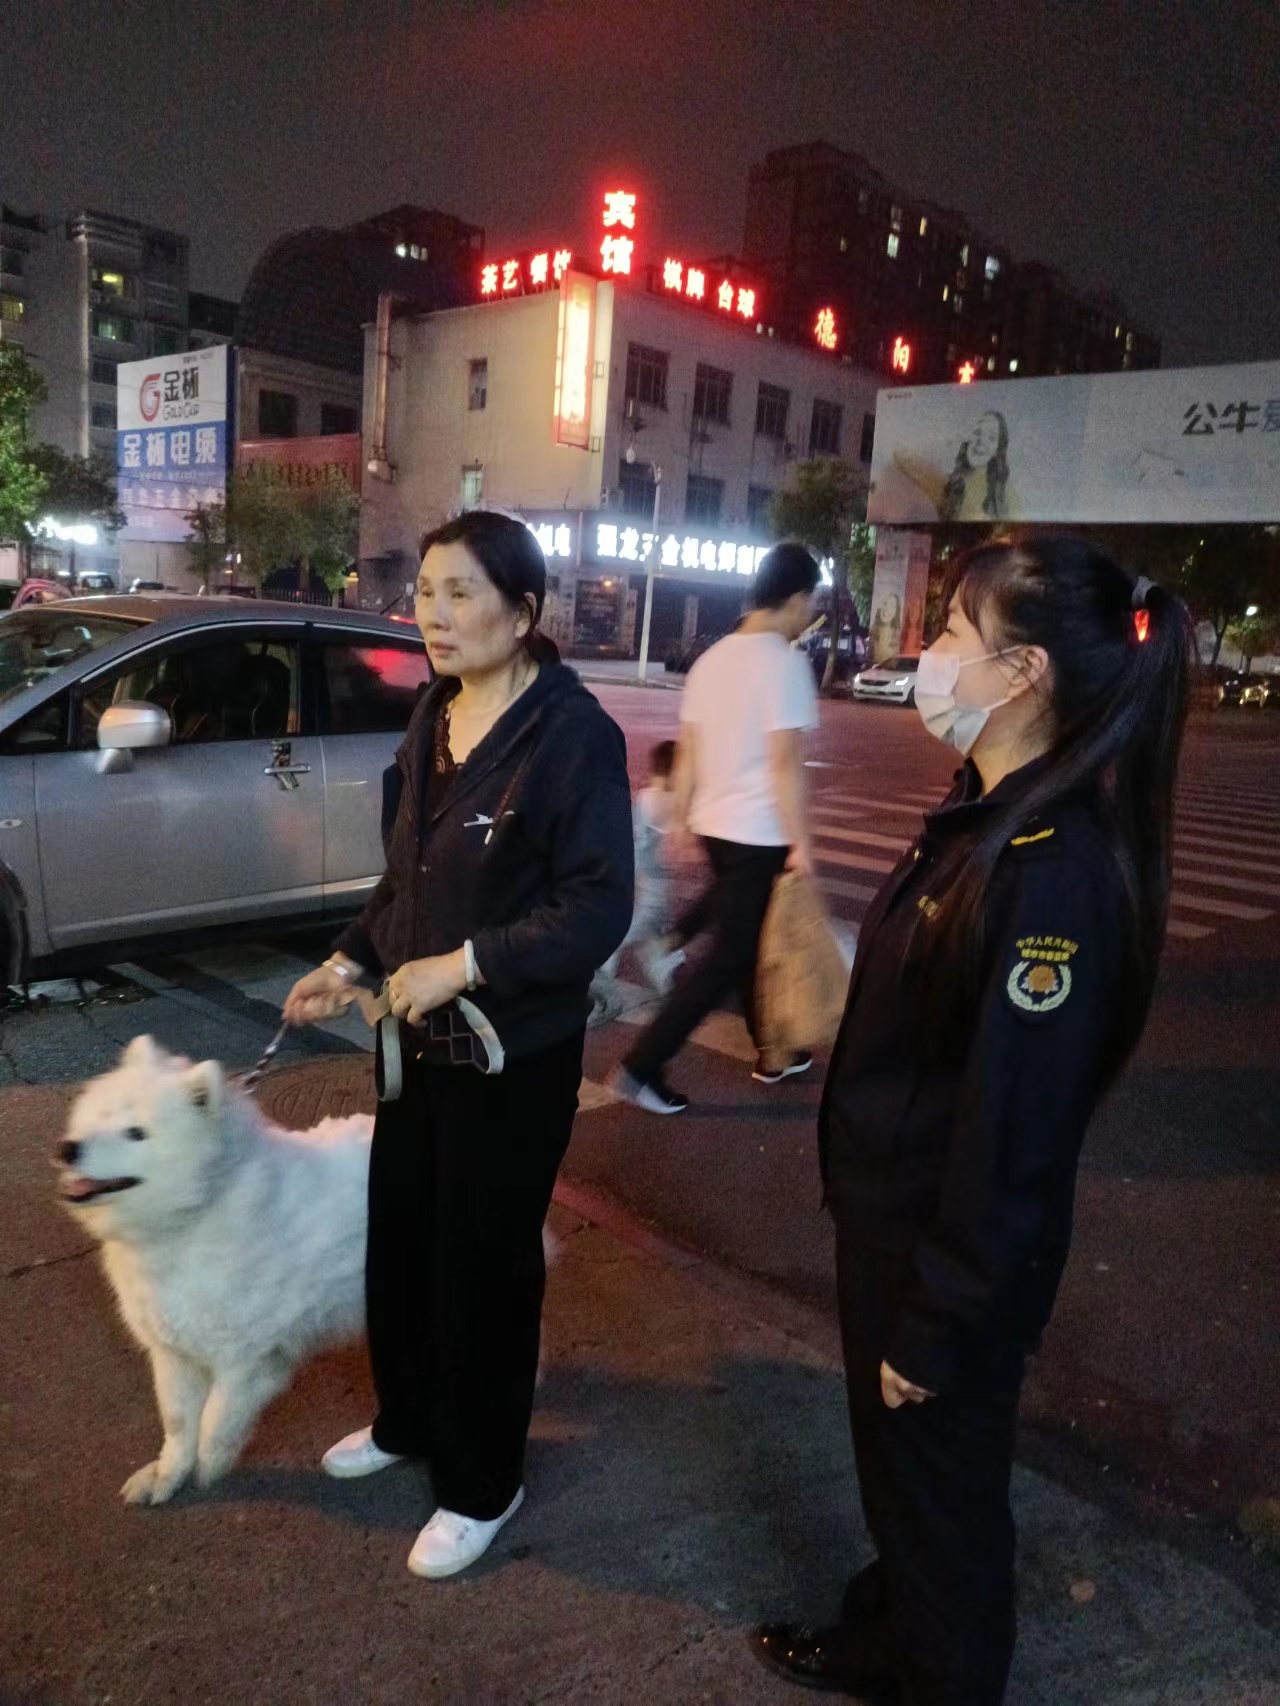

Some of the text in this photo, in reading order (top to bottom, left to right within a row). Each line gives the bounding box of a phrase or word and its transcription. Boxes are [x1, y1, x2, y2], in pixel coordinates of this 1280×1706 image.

[599, 190, 637, 275] 宾馆
[481, 262, 519, 294] 茶艺
[662, 257, 756, 318] 棋牌 台球
